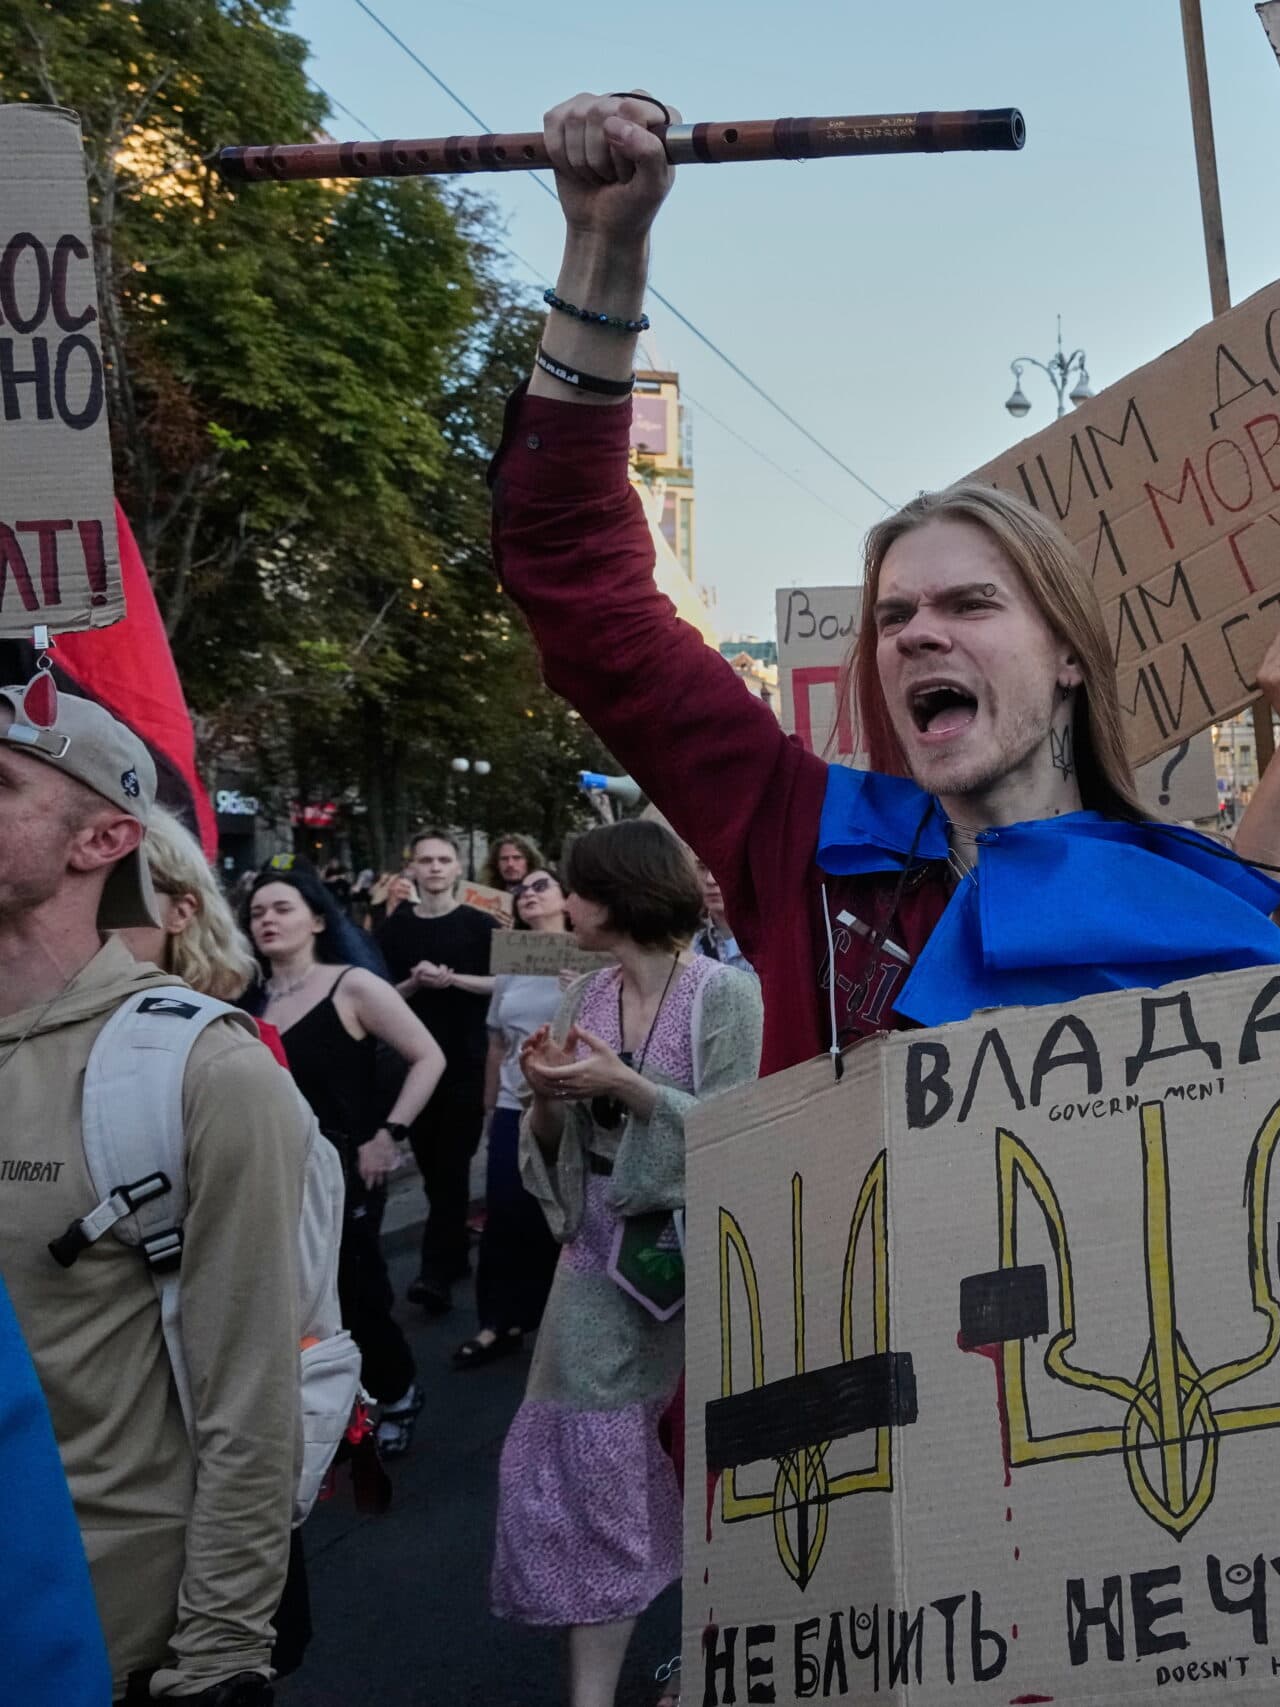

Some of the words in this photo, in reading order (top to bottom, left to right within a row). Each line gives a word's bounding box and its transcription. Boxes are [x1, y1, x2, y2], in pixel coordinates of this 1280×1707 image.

[0, 231, 97, 334] ОС
[701, 1621, 777, 1707] НЕ
[794, 1590, 1008, 1698] БАЧИТЬ
[1066, 1564, 1188, 1666] НЕ
